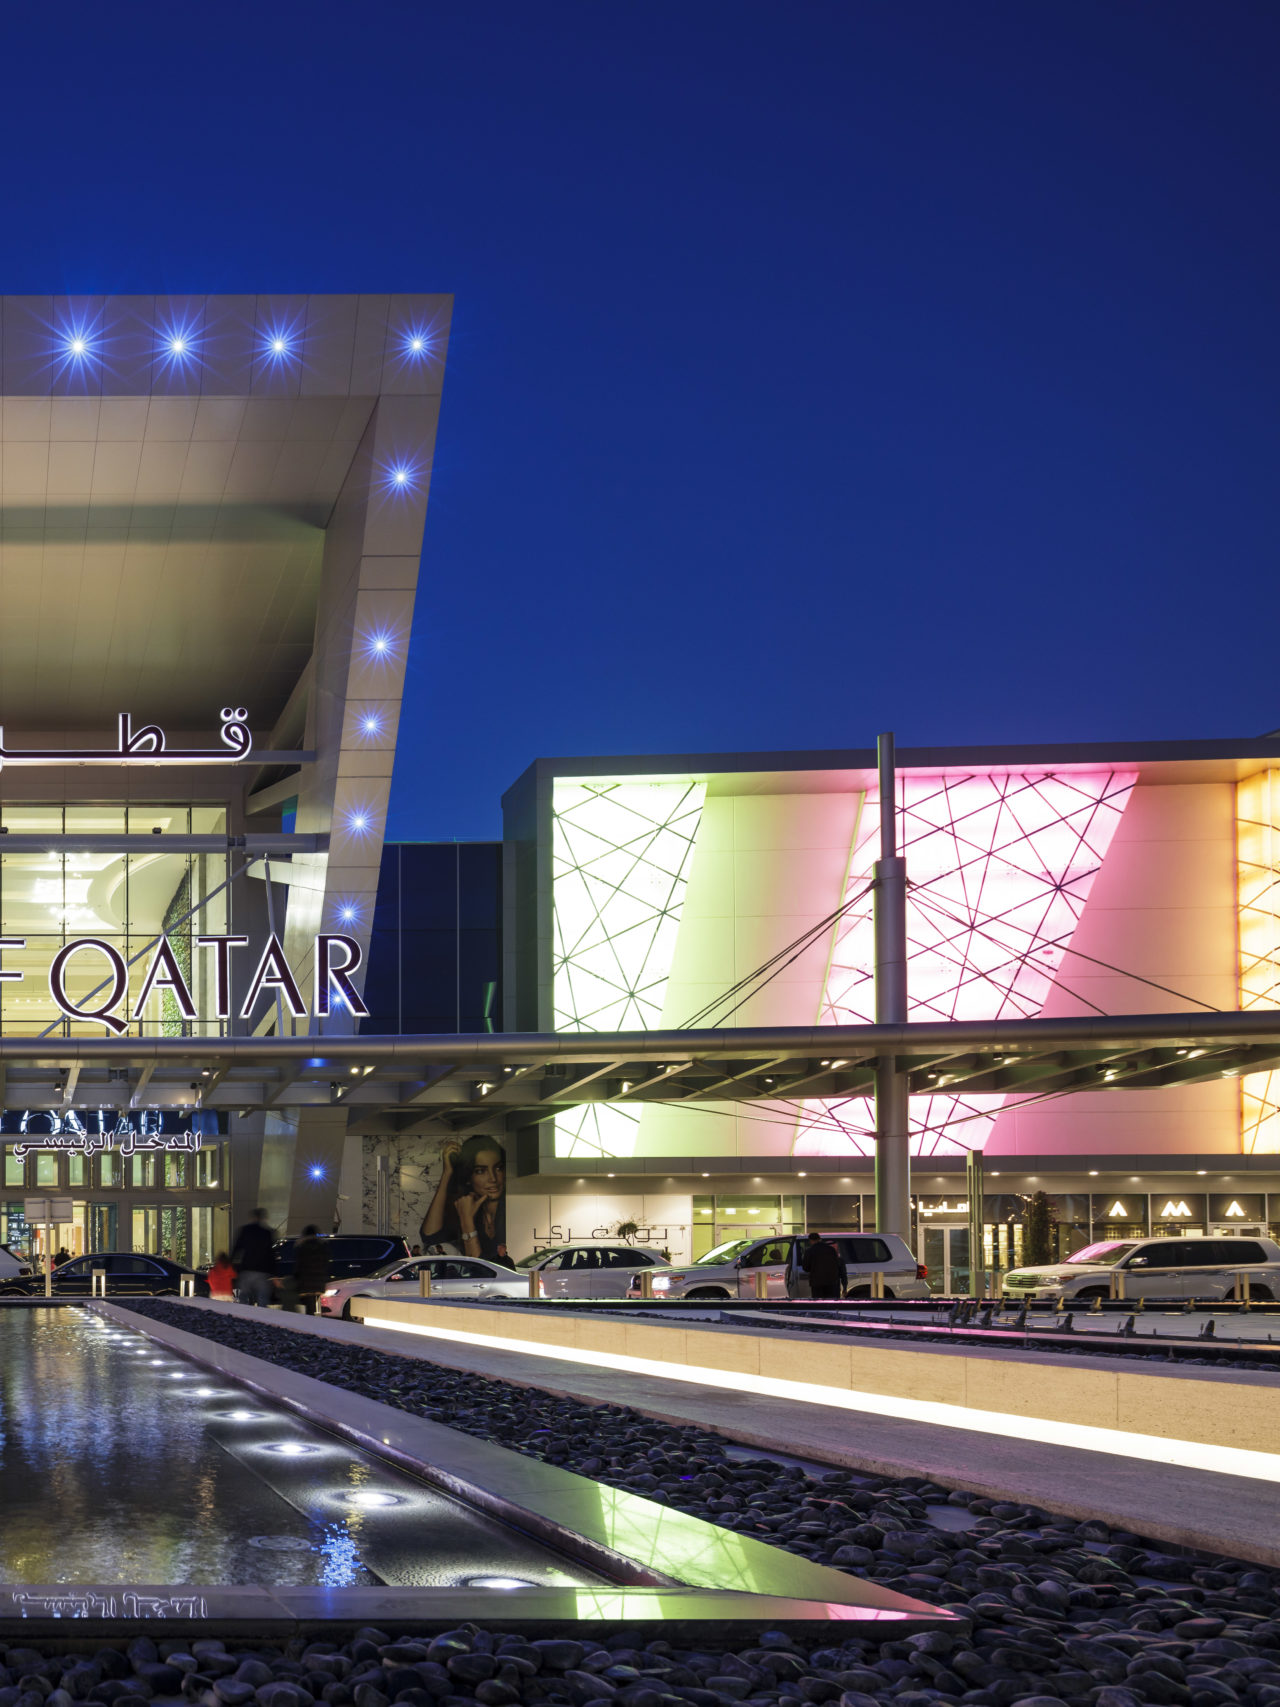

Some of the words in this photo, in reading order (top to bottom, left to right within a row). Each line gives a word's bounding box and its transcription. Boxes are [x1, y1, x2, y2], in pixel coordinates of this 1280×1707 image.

[48, 931, 371, 1036] QATAR
[13, 1129, 115, 1163] الرئيسي
[120, 1130, 202, 1157] المدخل
